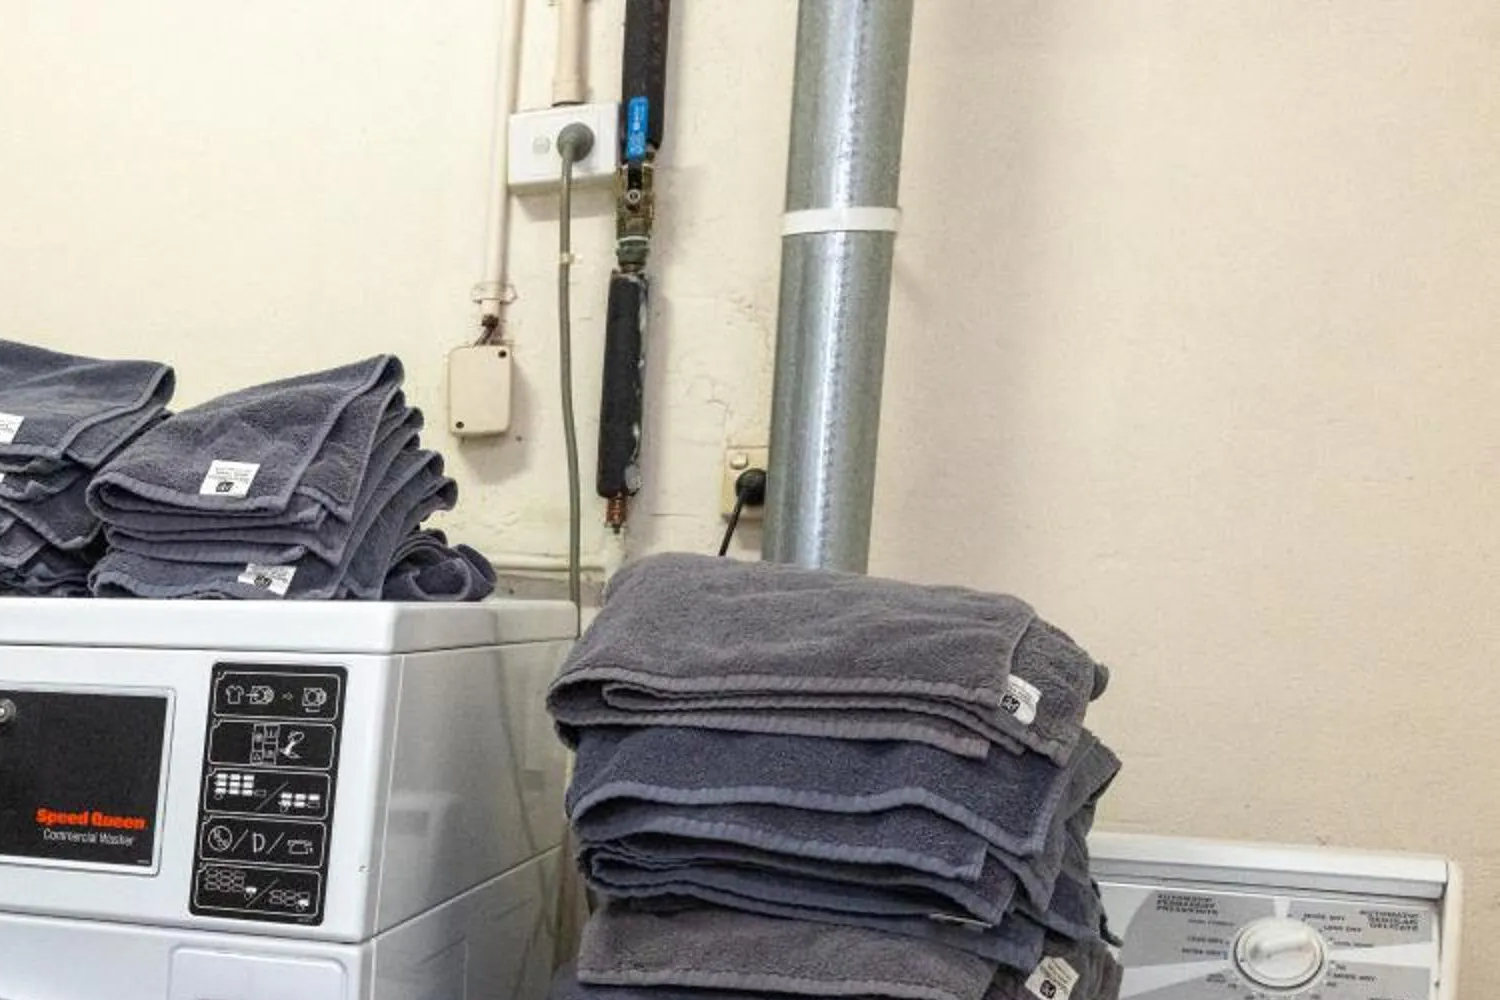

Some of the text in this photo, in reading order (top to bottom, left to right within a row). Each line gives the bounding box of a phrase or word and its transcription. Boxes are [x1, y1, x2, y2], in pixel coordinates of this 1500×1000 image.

[36, 807, 145, 829] Speed Queen
[43, 828, 134, 847] Commercial Washer
